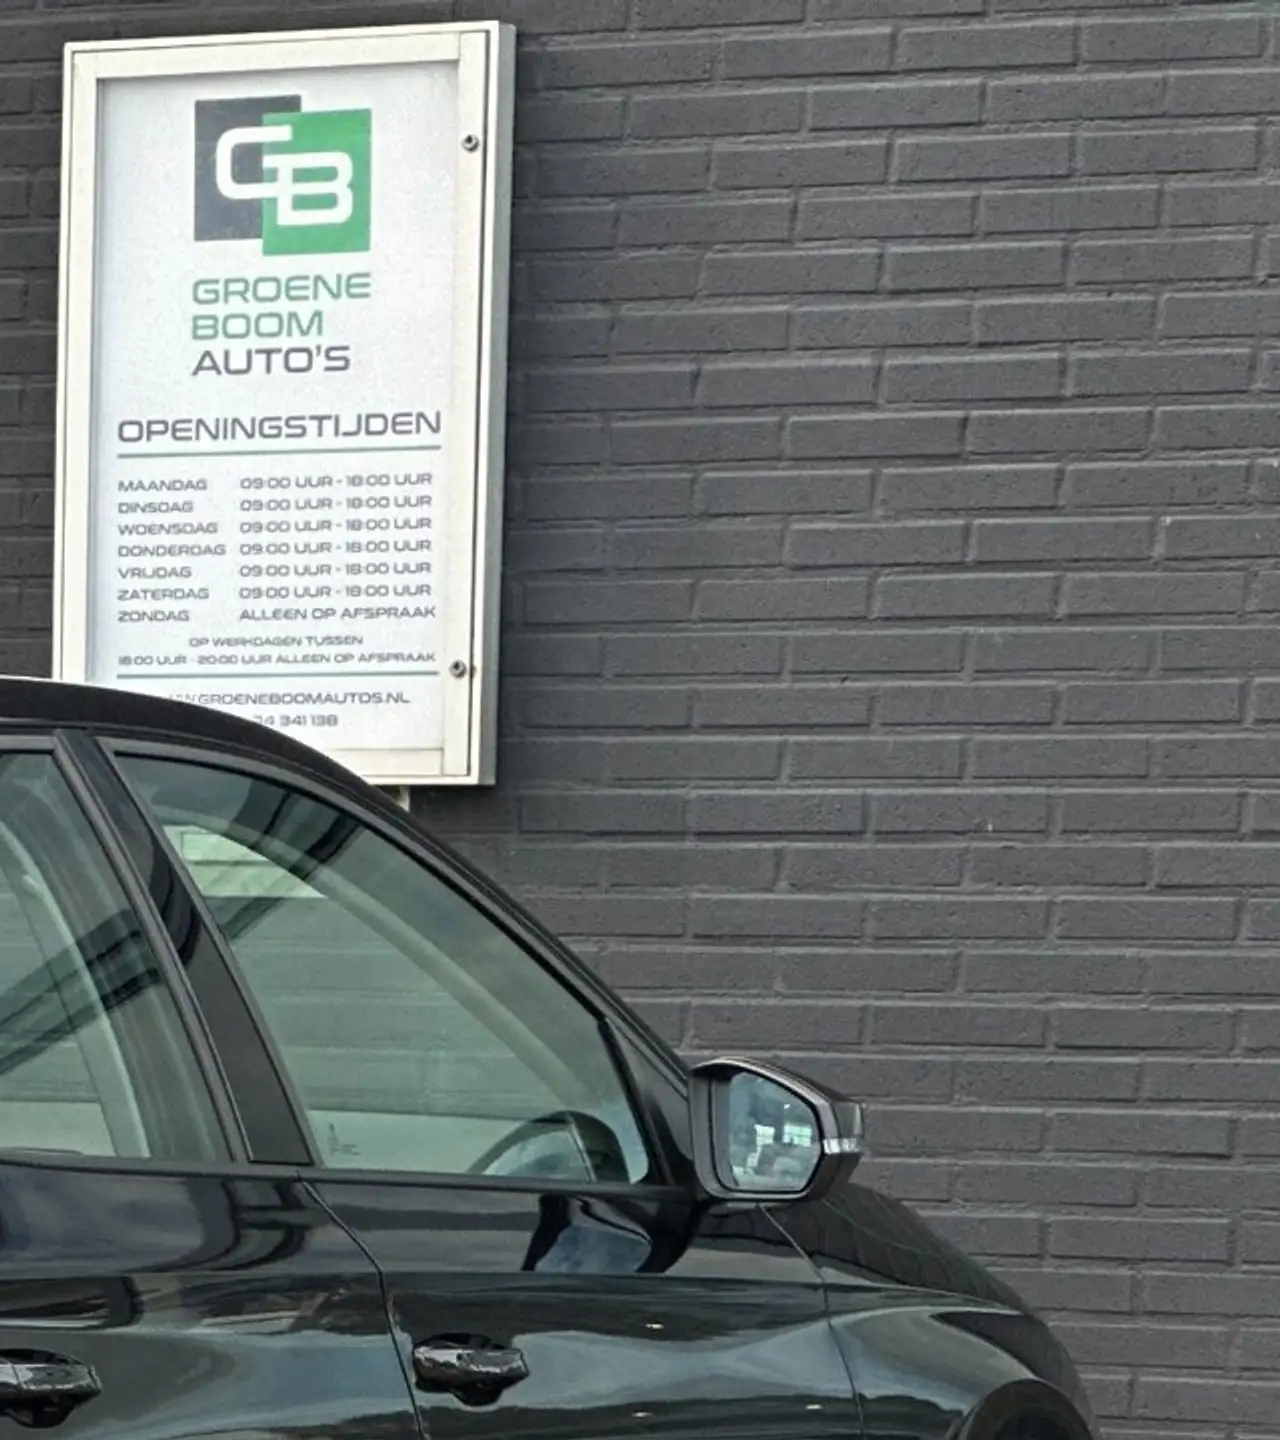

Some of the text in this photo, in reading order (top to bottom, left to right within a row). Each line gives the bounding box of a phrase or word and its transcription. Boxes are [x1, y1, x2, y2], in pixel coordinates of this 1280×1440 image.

[192, 272, 371, 305] GROENE
[192, 310, 323, 341] BOOM
[192, 346, 350, 375] AUTO'S
[118, 412, 441, 442] OPENINGSTIJDEN
[118, 479, 207, 492] MAANDAG
[240, 477, 291, 490] 09:00
[295, 475, 333, 489] UUR
[346, 474, 390, 487] 18:00
[394, 472, 433, 486] UUR
[118, 501, 193, 514] DINSDAG
[240, 499, 291, 511] 09:00
[295, 498, 333, 510] UUR
[346, 496, 390, 509] 18:00
[394, 495, 432, 508] UUR
[117, 522, 218, 536] WOENSDAG
[240, 520, 291, 534] 09:00
[294, 520, 332, 532] UUR
[346, 518, 390, 531] 18:00
[394, 517, 432, 530] UUR
[118, 544, 226, 557] DONDERDAG
[240, 543, 291, 555] 09:00
[294, 542, 332, 554] UUR
[346, 540, 390, 553] 18:00
[393, 540, 431, 552] UUR
[118, 566, 192, 579] VRIJDAG
[238, 564, 290, 577] 09:00
[294, 564, 332, 576] UUR
[345, 562, 390, 575] 18:00
[393, 562, 431, 575] UUR
[117, 588, 209, 601] ZATERDAG
[239, 586, 290, 599] 09:00
[294, 586, 332, 599] UUR
[345, 584, 390, 597] 18:00
[393, 584, 431, 597] UUR
[118, 606, 435, 623] ZONDAG ALLEEN OP AFSPRAAK
